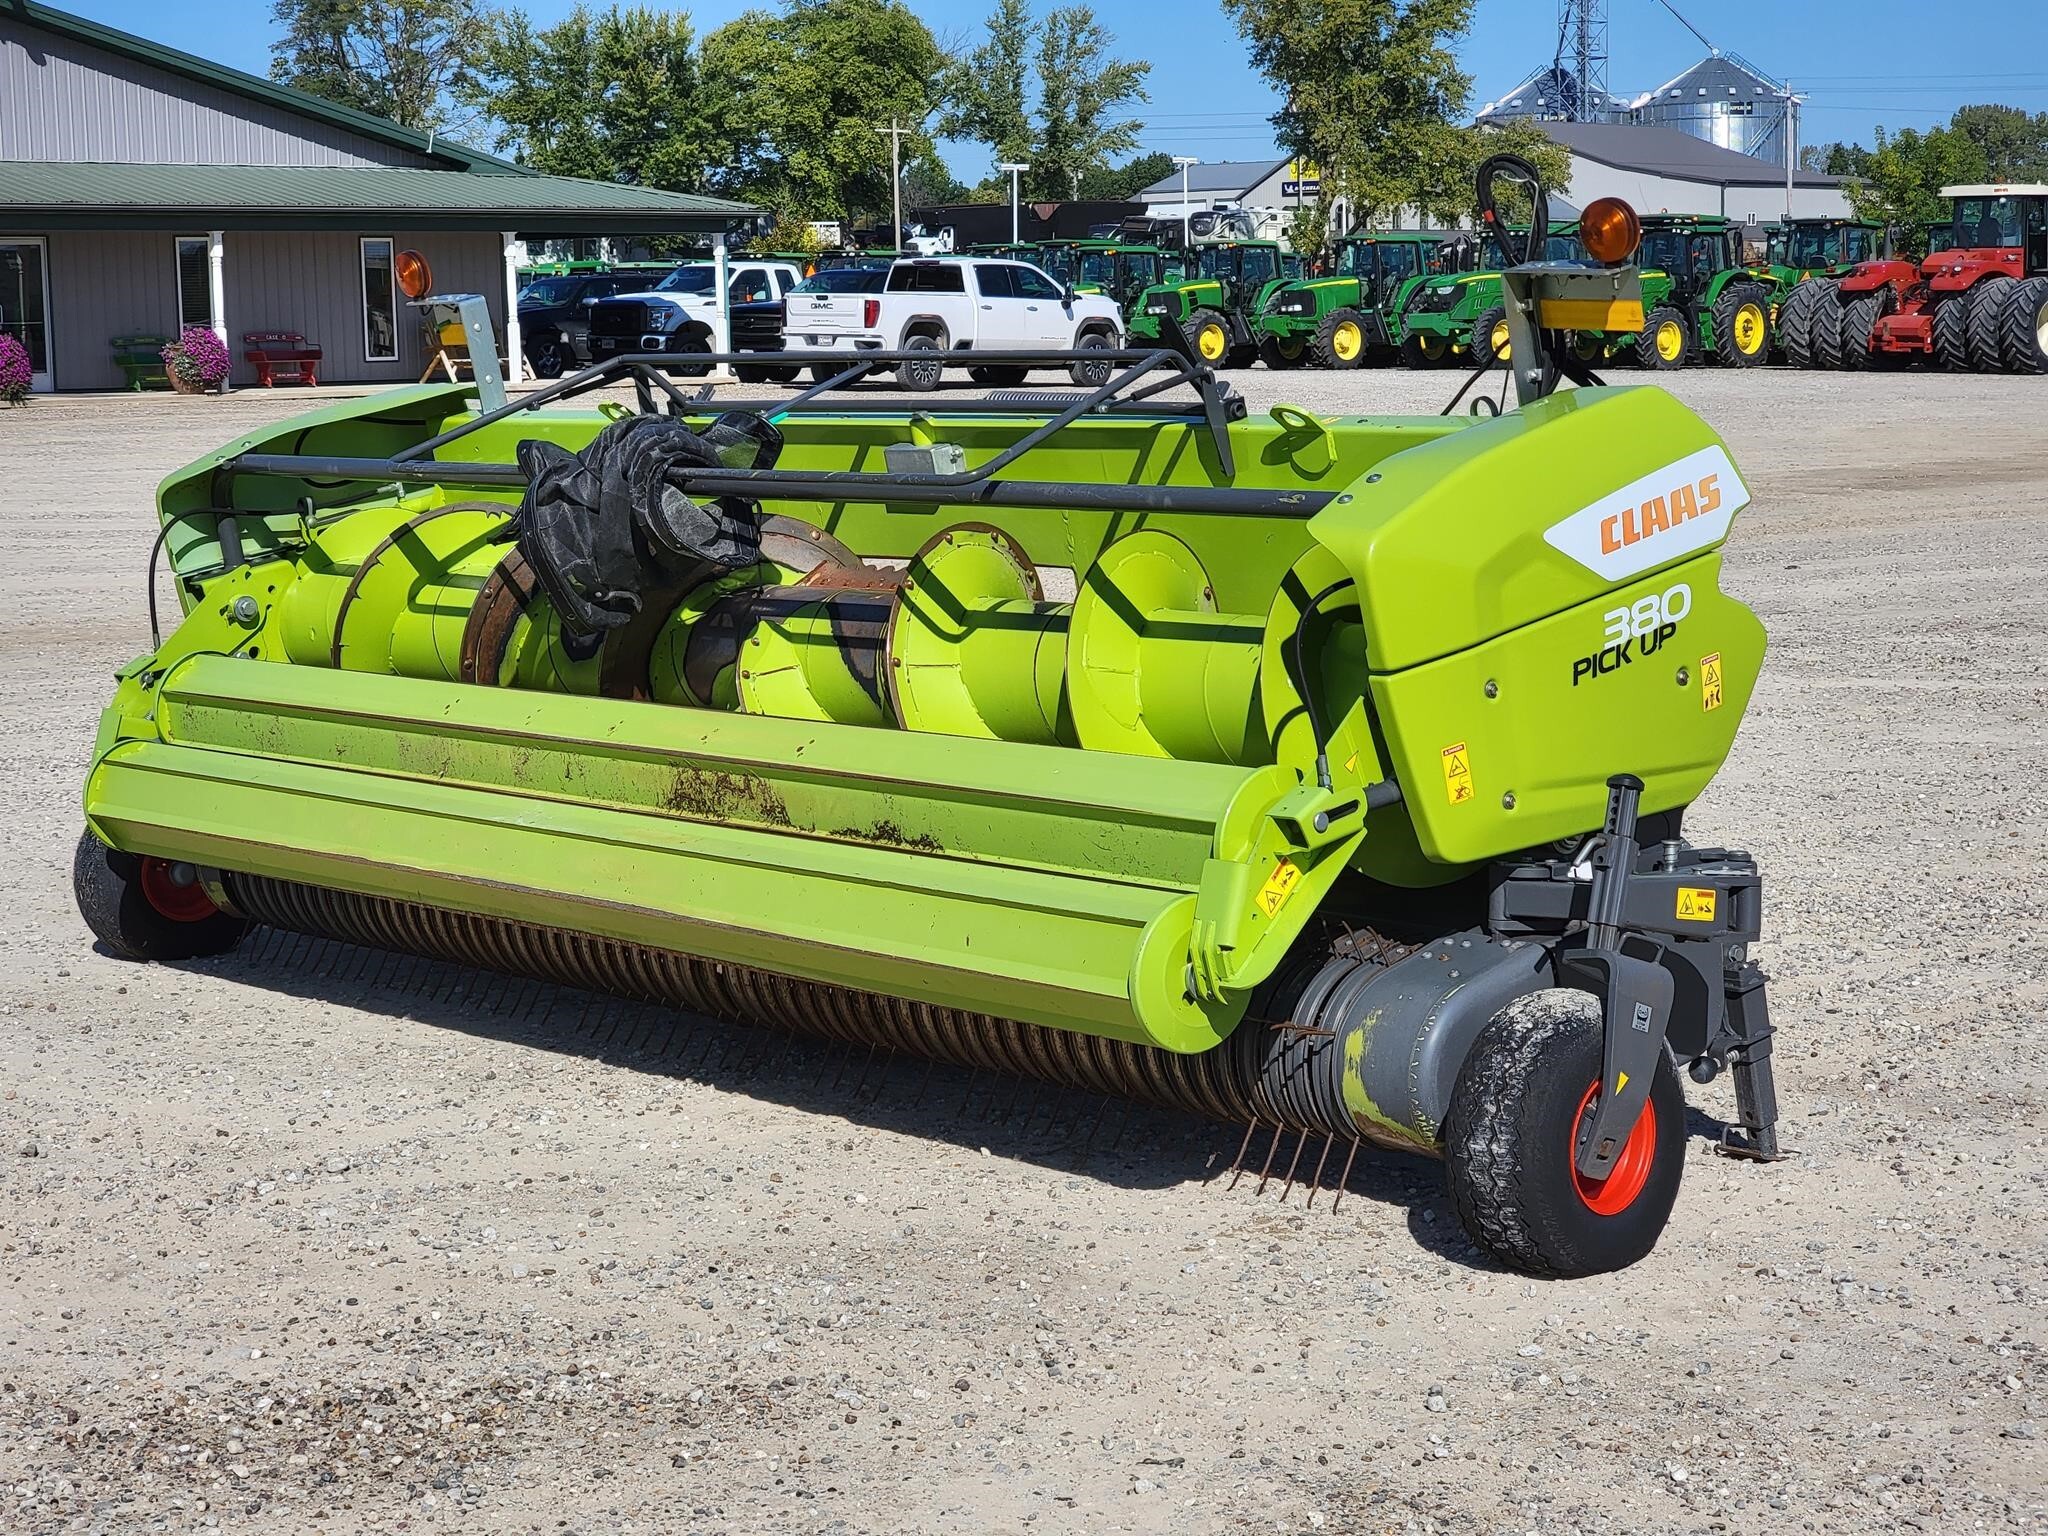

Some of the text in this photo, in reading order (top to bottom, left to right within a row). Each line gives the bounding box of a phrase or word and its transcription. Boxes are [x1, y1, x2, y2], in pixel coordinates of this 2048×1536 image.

[1600, 473, 1721, 555] CLAAS
[1604, 583, 1692, 649] 380
[1572, 621, 1677, 687] PICK UP
